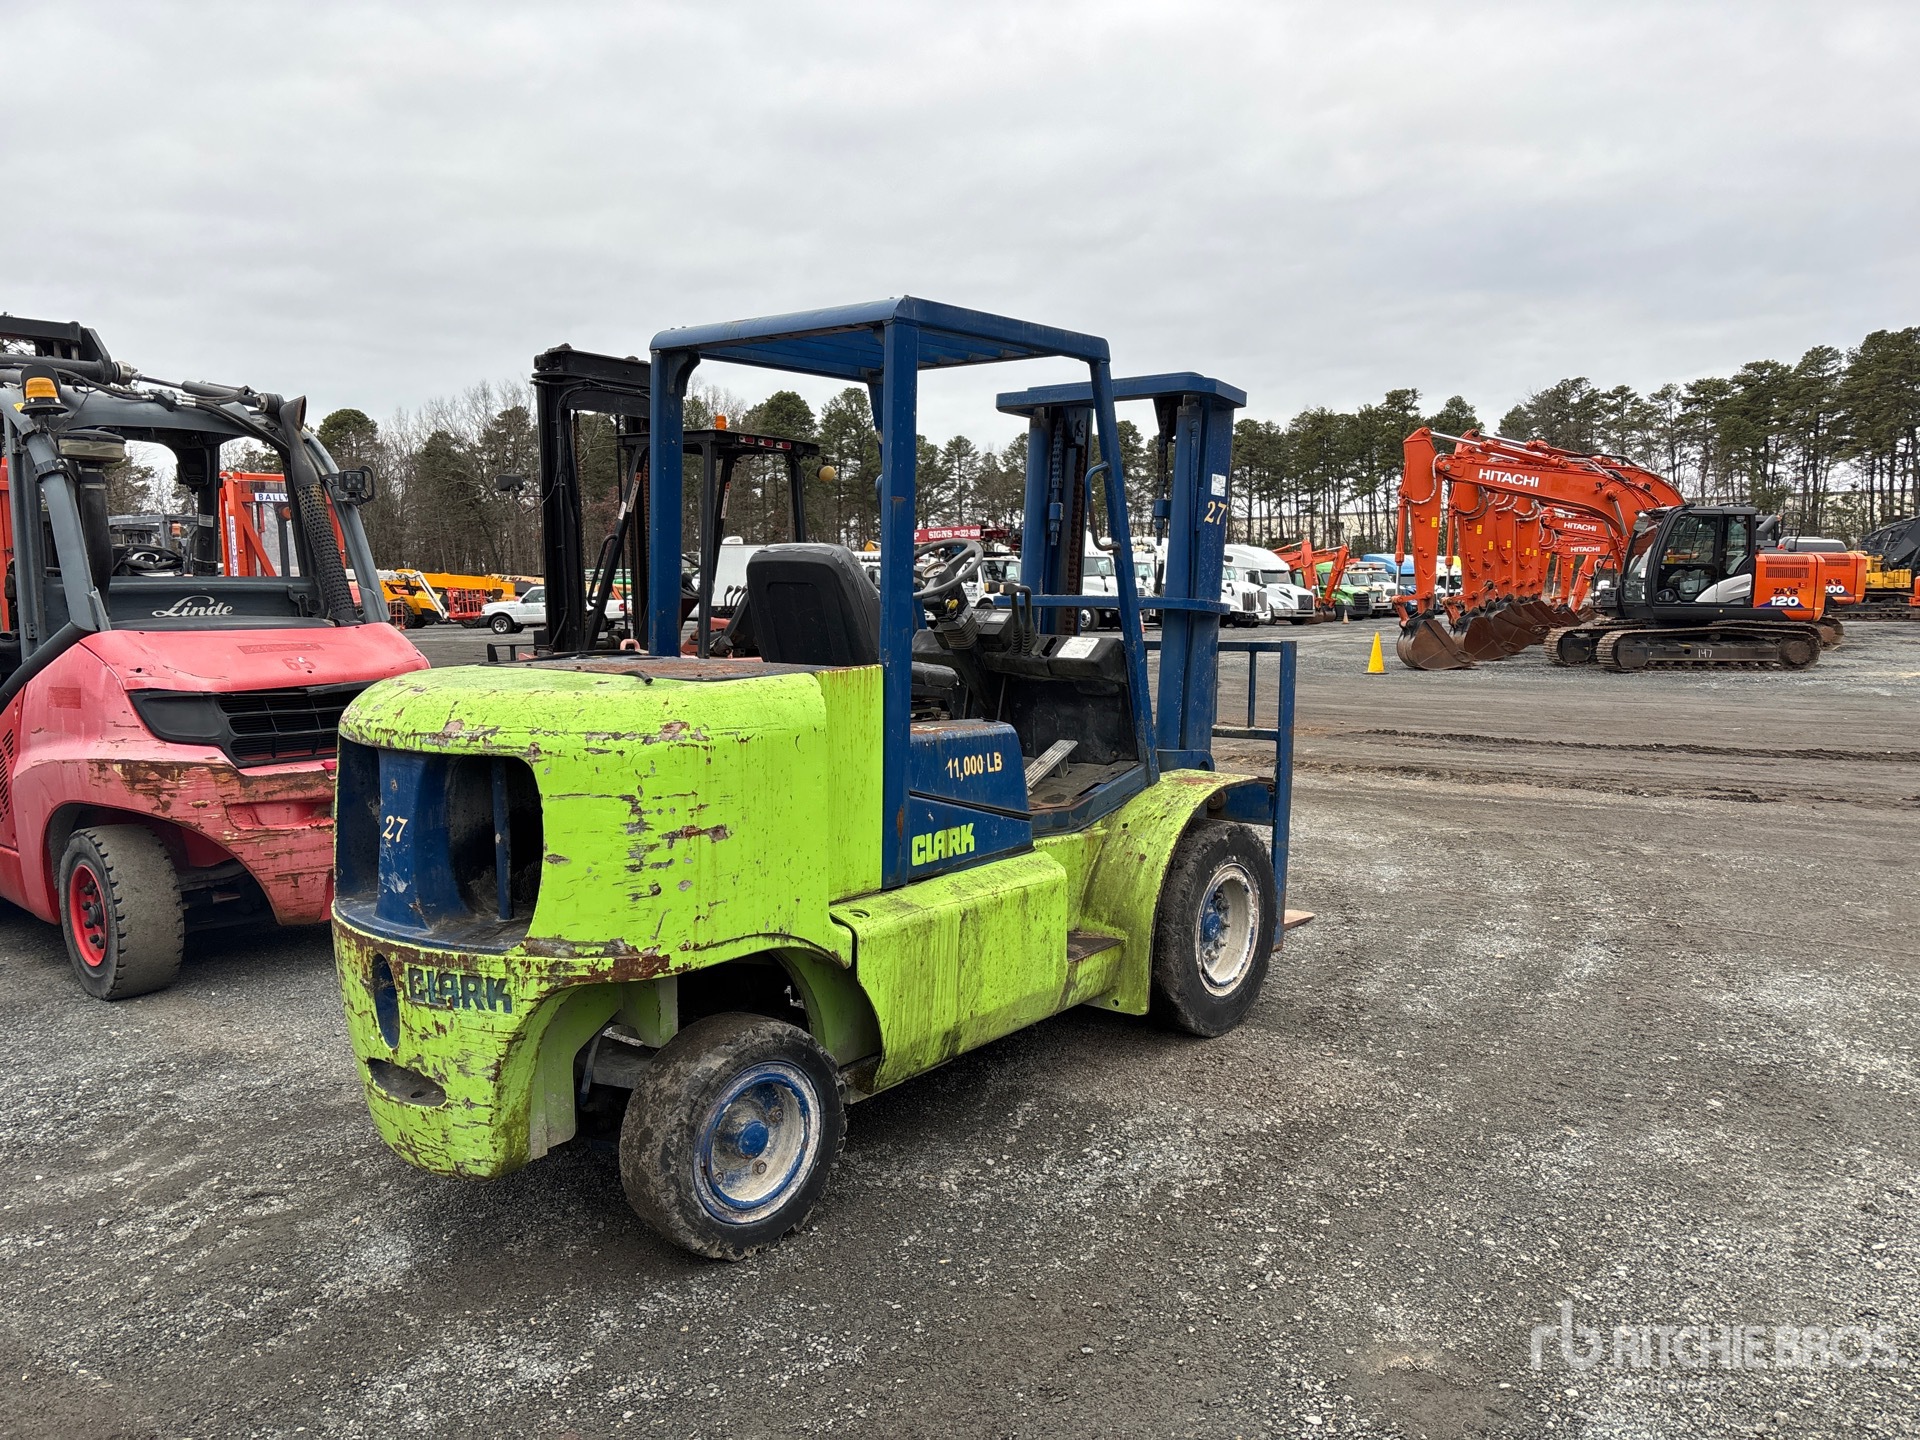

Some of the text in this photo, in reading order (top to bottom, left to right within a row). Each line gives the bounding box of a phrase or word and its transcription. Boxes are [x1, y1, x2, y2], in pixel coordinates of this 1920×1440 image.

[1478, 468, 1540, 488] HITACHI
[258, 493, 288, 501] BALLY
[1204, 500, 1227, 525] 27
[928, 529, 953, 539] SIGNS
[1563, 521, 1597, 532] HITACHI
[152, 595, 233, 617] Linde
[1770, 595, 1800, 607] 120
[1698, 648, 1713, 658] 147
[945, 751, 1003, 782] 11,000 LB
[382, 815, 408, 843] 27
[911, 822, 975, 867] CLARK
[408, 967, 513, 1014] CLARK
